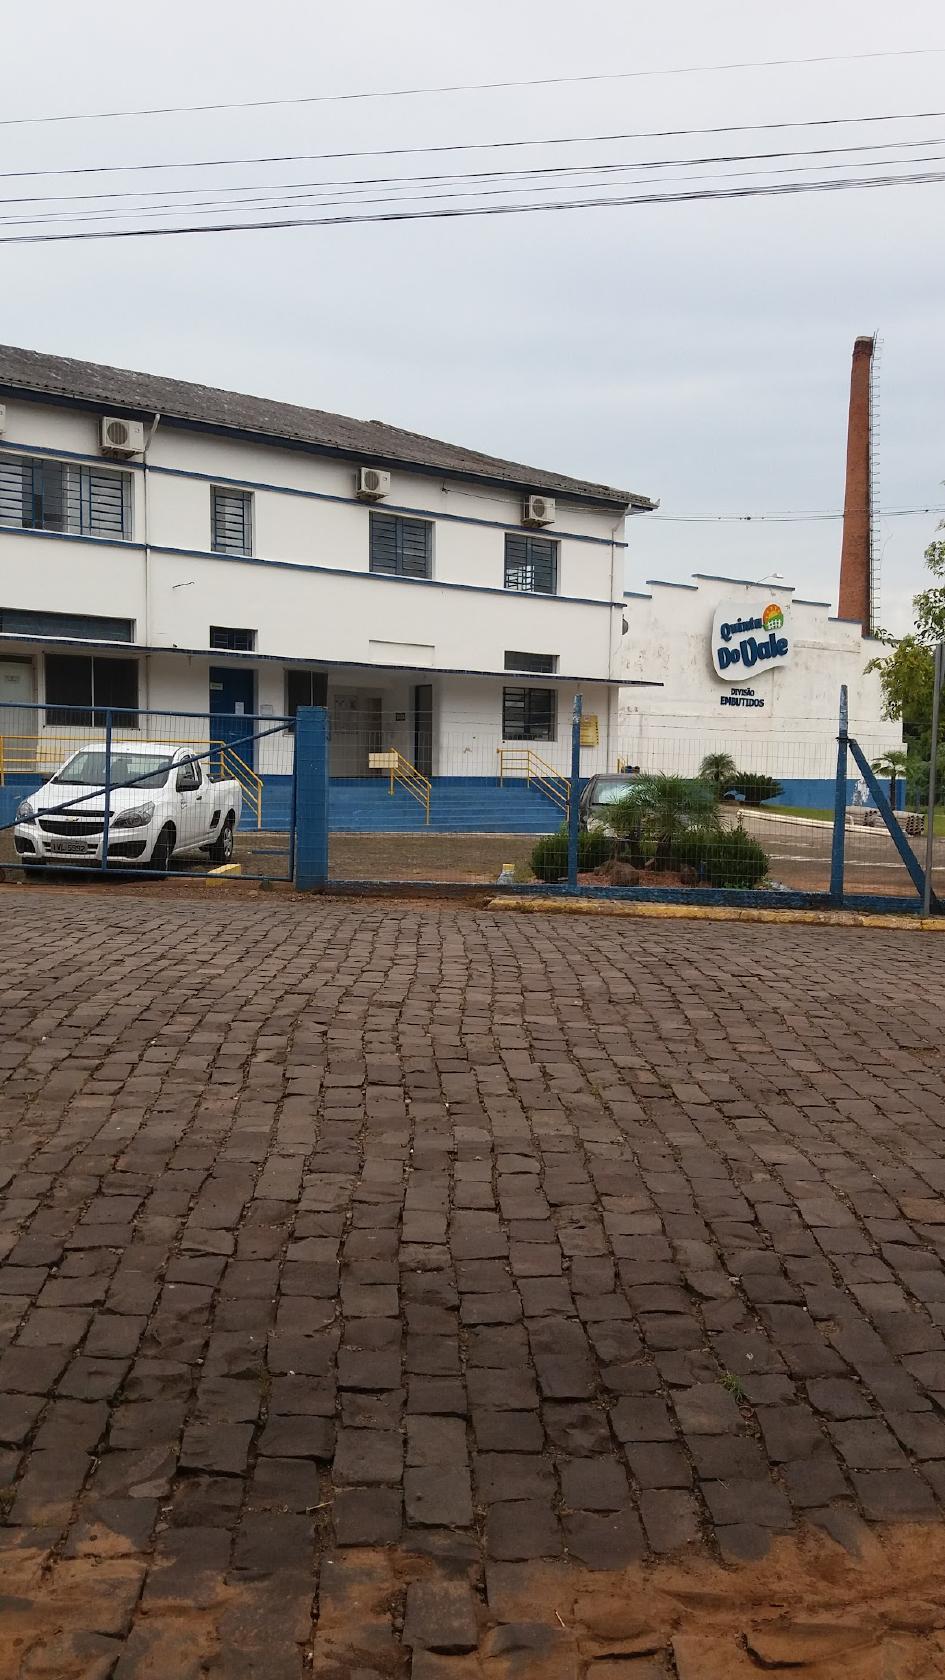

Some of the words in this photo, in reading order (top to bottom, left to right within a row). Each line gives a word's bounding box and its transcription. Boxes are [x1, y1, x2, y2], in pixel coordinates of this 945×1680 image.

[720, 617, 762, 641] Quinta
[731, 688, 754, 696] DIVISÃO
[720, 696, 764, 707] EMBUTIDOS
